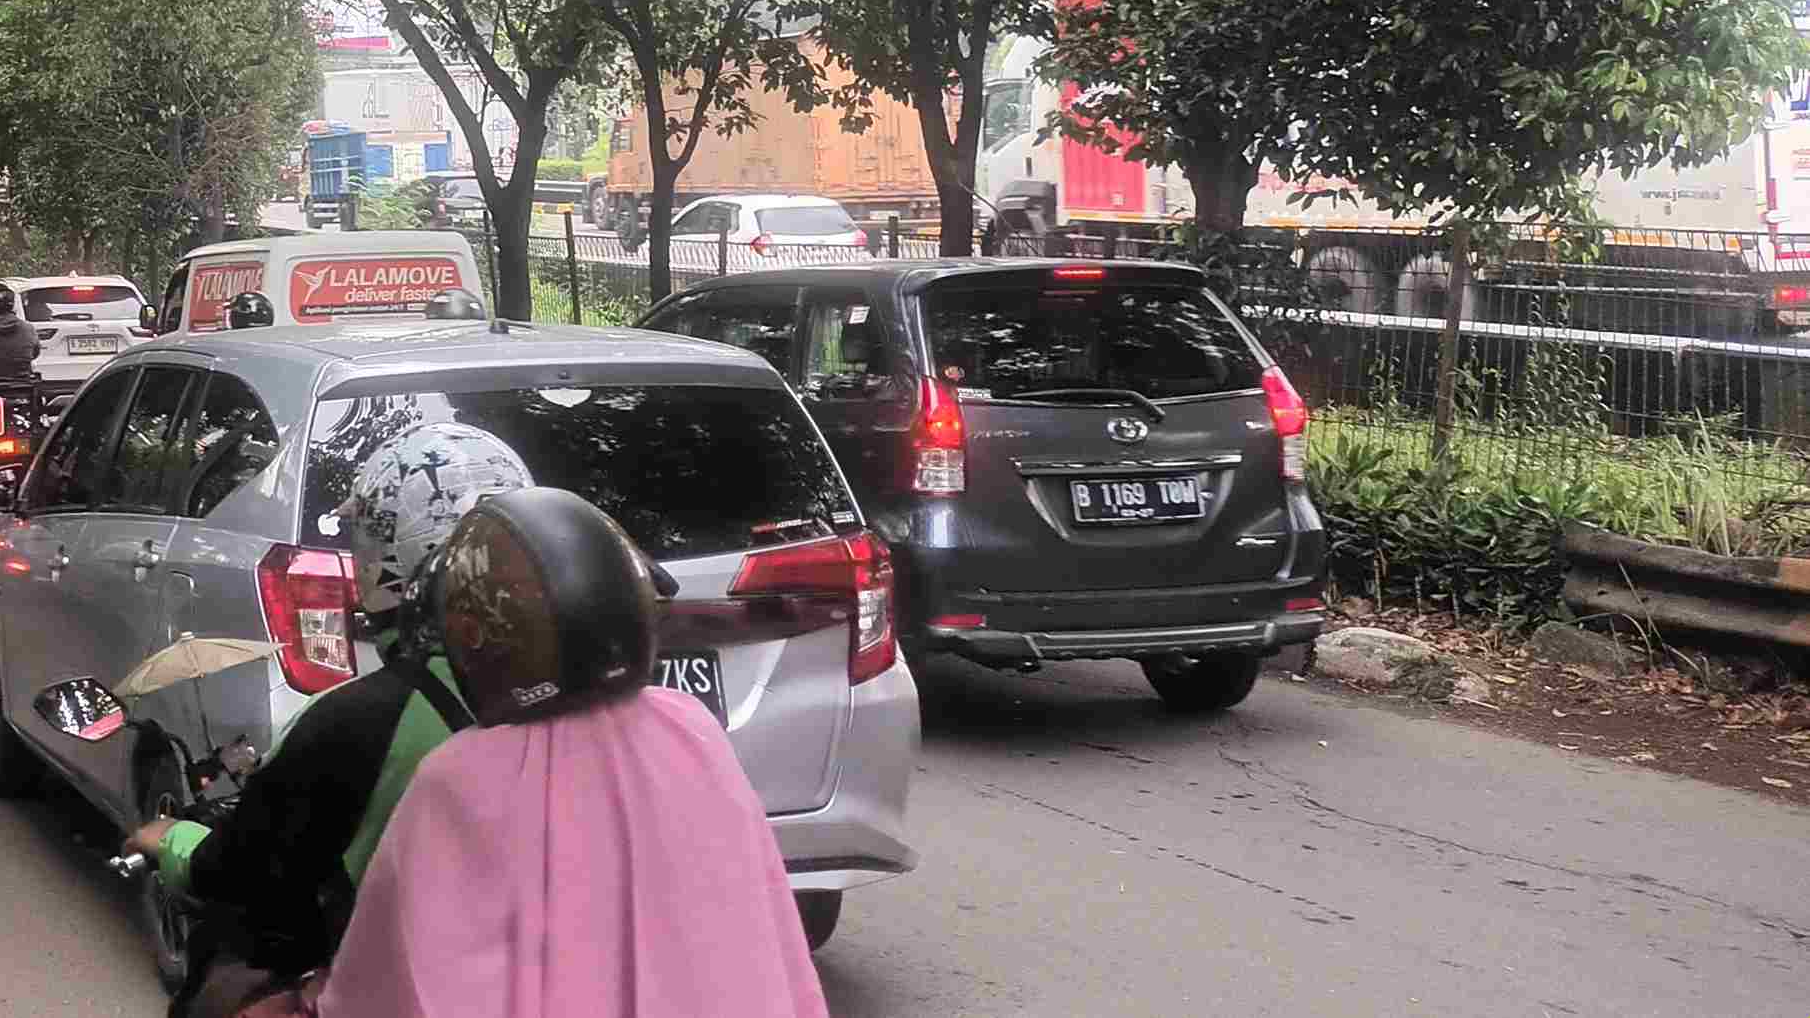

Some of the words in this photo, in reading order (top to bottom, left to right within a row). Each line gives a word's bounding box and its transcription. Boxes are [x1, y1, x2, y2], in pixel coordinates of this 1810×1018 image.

[329, 266, 455, 288] LALAMOVE
[344, 287, 398, 304] deliver
[1075, 484, 1091, 507] B
[1100, 482, 1146, 506] 1169
